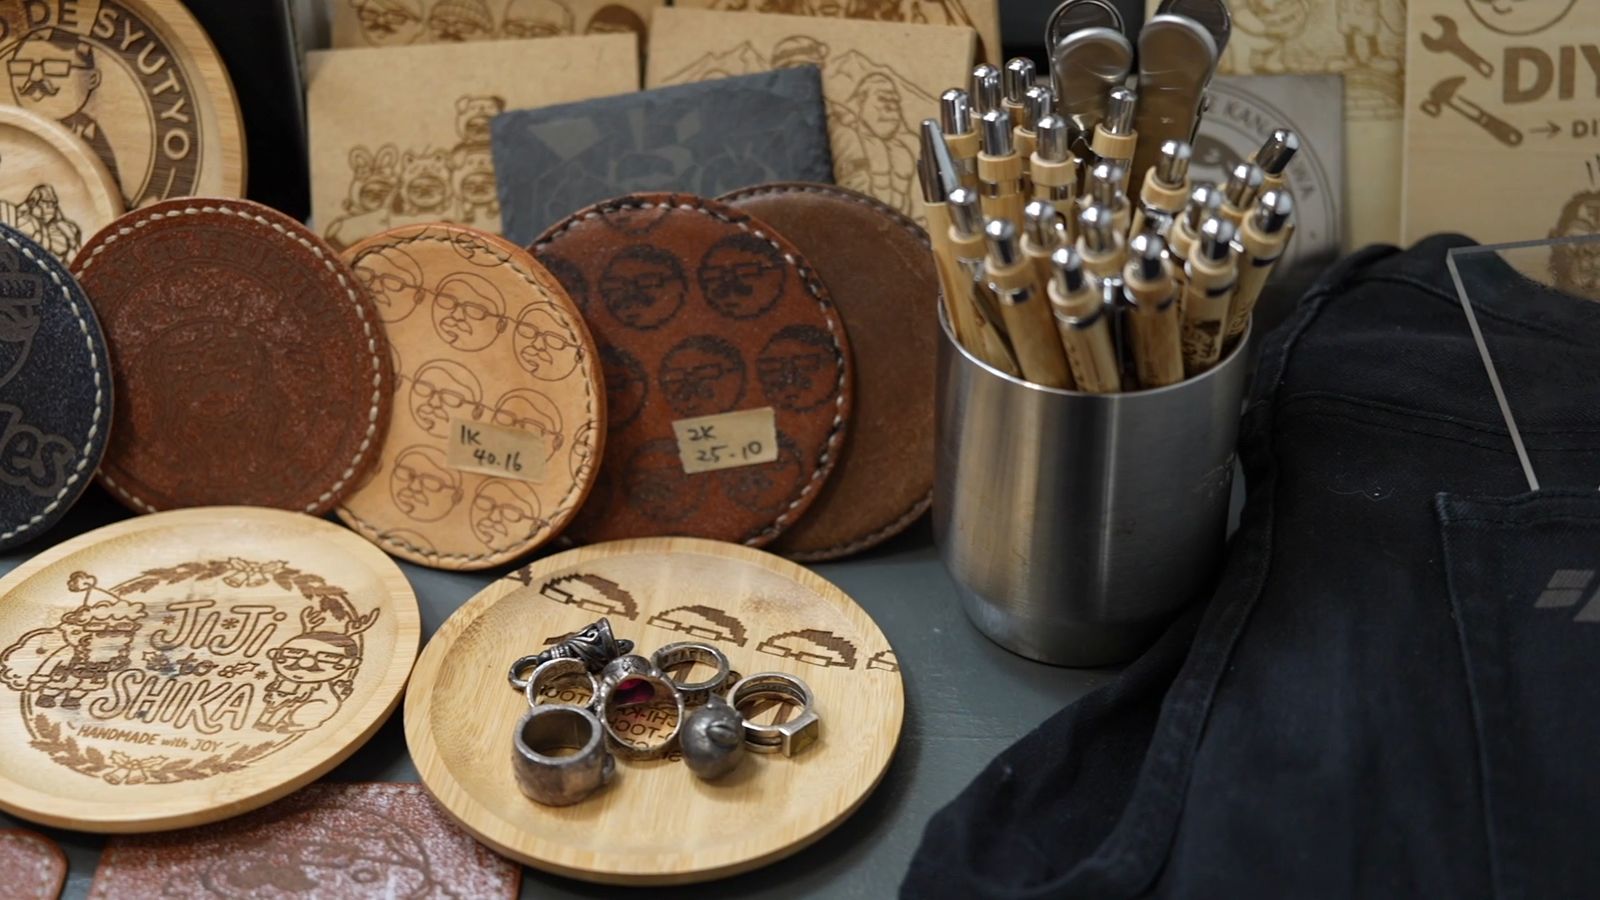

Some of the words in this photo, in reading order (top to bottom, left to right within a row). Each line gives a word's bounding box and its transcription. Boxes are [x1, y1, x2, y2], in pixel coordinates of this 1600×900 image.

[93, 8, 190, 160] SYUTYO
[473, 448, 523, 472] 40.16
[88, 668, 255, 735] SHIKA
[76, 724, 161, 746] HANDMADE
[161, 736, 189, 749] with
[190, 738, 223, 752] JOY
